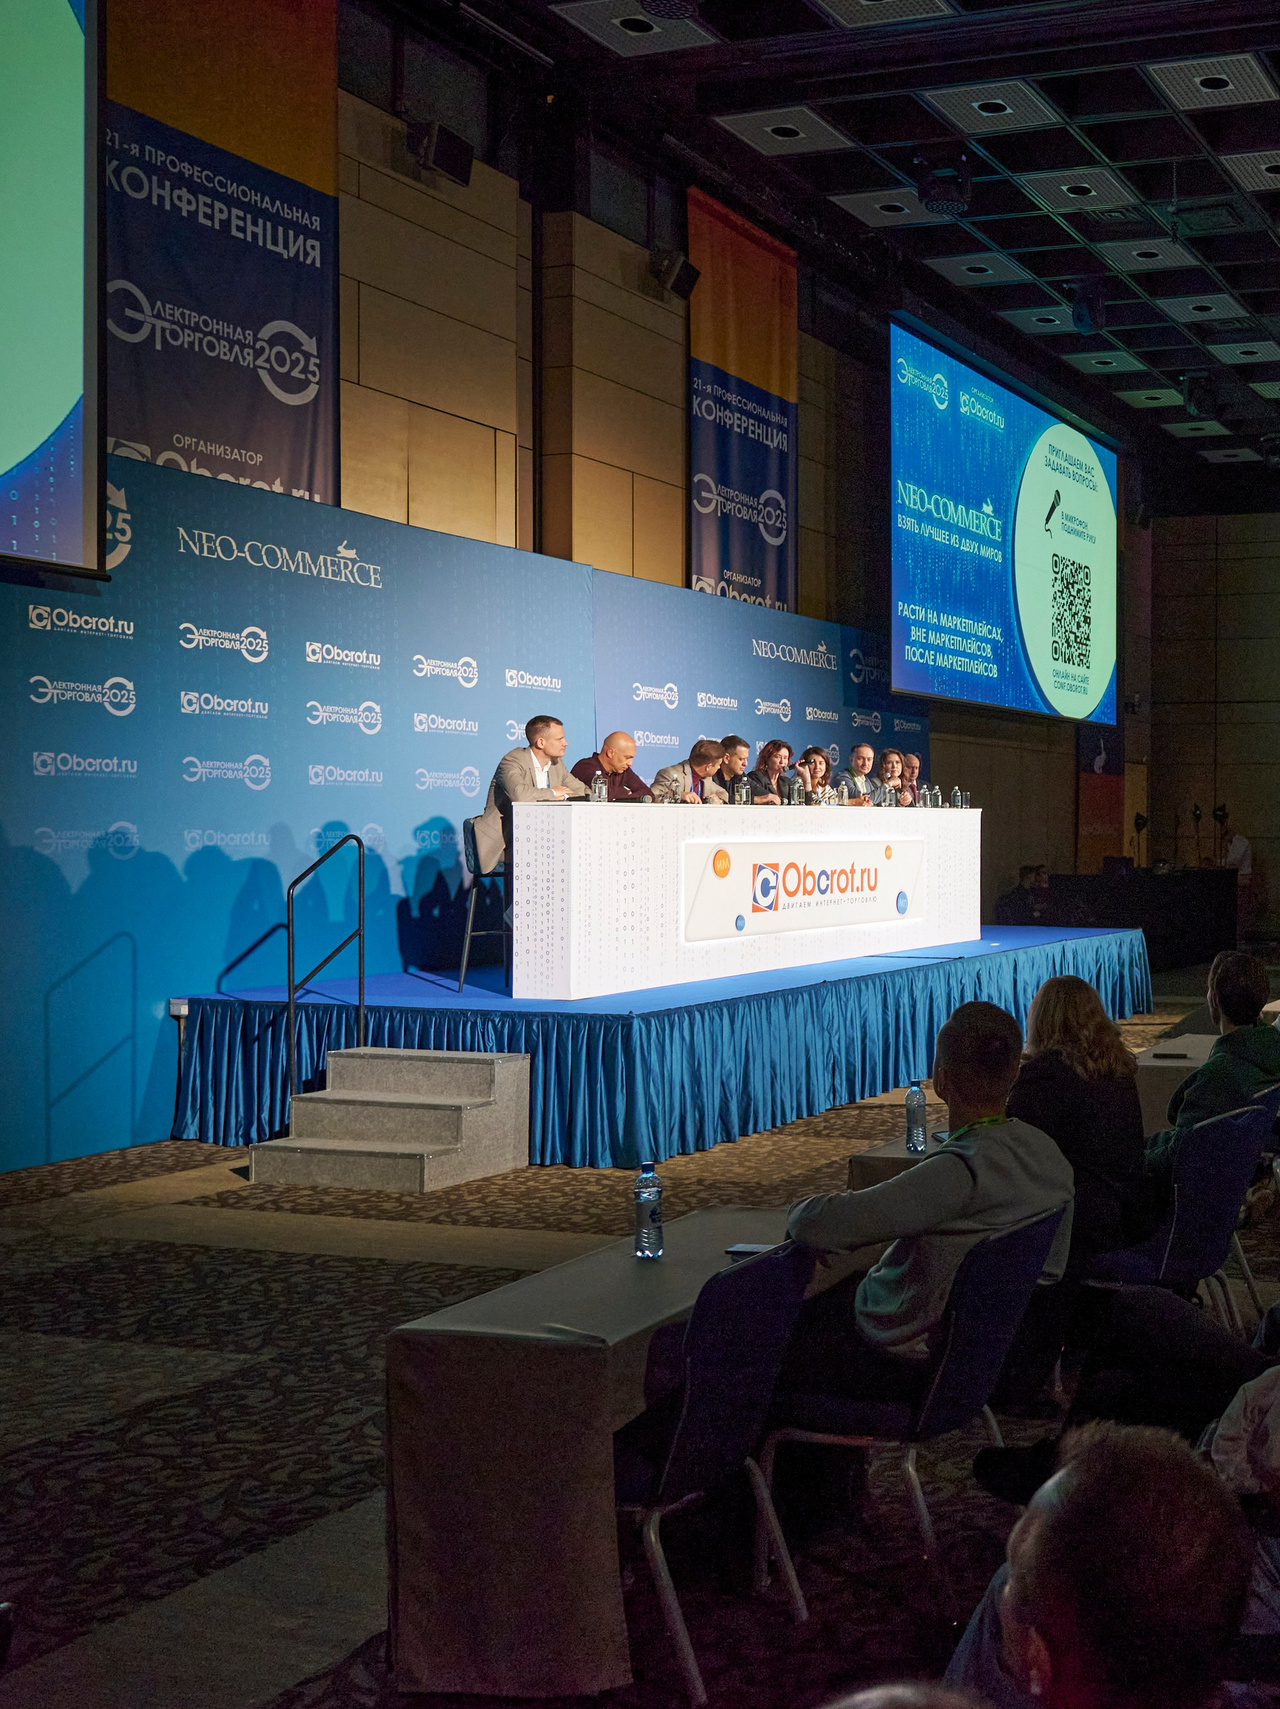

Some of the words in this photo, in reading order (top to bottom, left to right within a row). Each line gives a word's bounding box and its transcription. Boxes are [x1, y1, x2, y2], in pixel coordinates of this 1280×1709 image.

[145, 145, 320, 231] ПРОФЕССИОНАЛЬНАЯ
[106, 155, 321, 268] КОНФЕРЕНЦИЯ
[255, 339, 321, 384] 2025
[693, 376, 712, 394] 21-я
[713, 385, 788, 428] ПРОФЕССИОНАЛЬНАЯ
[693, 394, 788, 452] КОНФЕРЕНЦИЯ
[173, 433, 264, 465] ОРГАНИЗАТОР
[1044, 455, 1071, 479] ЗАДАВАТЬ
[1084, 463, 1095, 478] ВАС
[758, 504, 787, 530] 2025
[897, 479, 1002, 542] NEO-COMMERCE
[897, 514, 919, 533] ВЗЯТЬ
[920, 522, 950, 544] ЛУЧШЕЕ
[951, 534, 960, 548] ИЗ
[960, 537, 979, 555] ДВУХ
[980, 546, 1002, 563] МИРОВ
[177, 526, 382, 588] NEO-COMMERCE
[723, 569, 762, 588] ОРГАНИЗАТОР
[898, 601, 925, 622] РАСТИ
[927, 609, 939, 625] НА
[198, 636, 240, 650] ТОРГОВЛЯ
[240, 637, 269, 651] 2025
[911, 626, 927, 644] ВНЕ
[752, 639, 838, 670] NEO-COMMERCE
[905, 645, 934, 665] ПОСЛЕ
[936, 652, 998, 678] МАРКЕТПЛЕЙСОВ
[457, 666, 478, 678] 2025
[29, 675, 102, 704] ЭЛЕКТРОННАЯ
[50, 688, 102, 704] ТОРГОВЛЯ
[102, 689, 136, 703] 2025
[358, 711, 382, 724] 2025
[243, 766, 271, 778] 2025
[460, 776, 480, 787] 2025
[106, 834, 140, 847] 2025
[782, 901, 812, 910] ДВИГАЕМ
[816, 896, 877, 906] ИНТЕРНЕТ-ТОРГОВЛЮ
